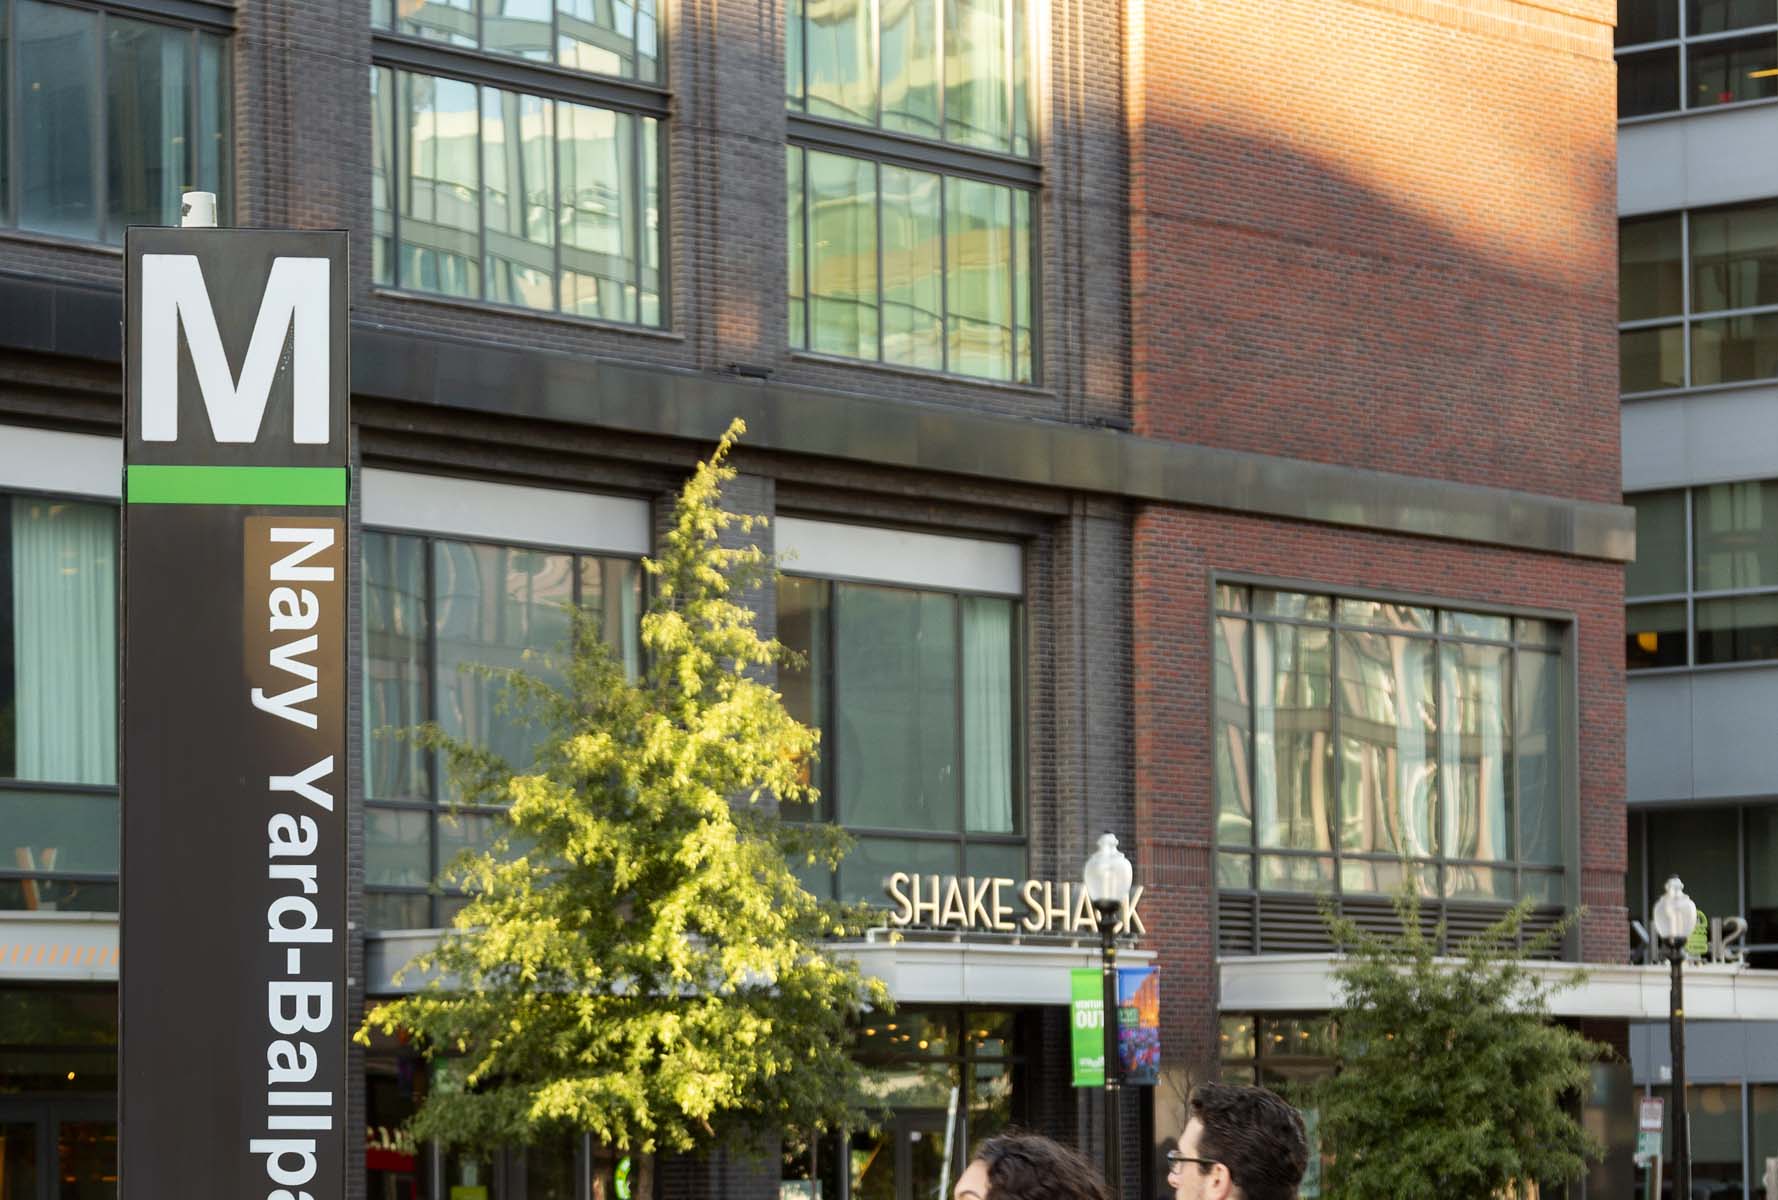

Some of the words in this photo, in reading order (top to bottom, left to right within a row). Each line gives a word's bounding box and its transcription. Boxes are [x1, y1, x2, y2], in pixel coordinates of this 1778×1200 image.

[139, 253, 330, 444] M
[251, 527, 335, 730] Navy
[889, 871, 1016, 931] SHAKE
[1022, 879, 1146, 935] SHAK
